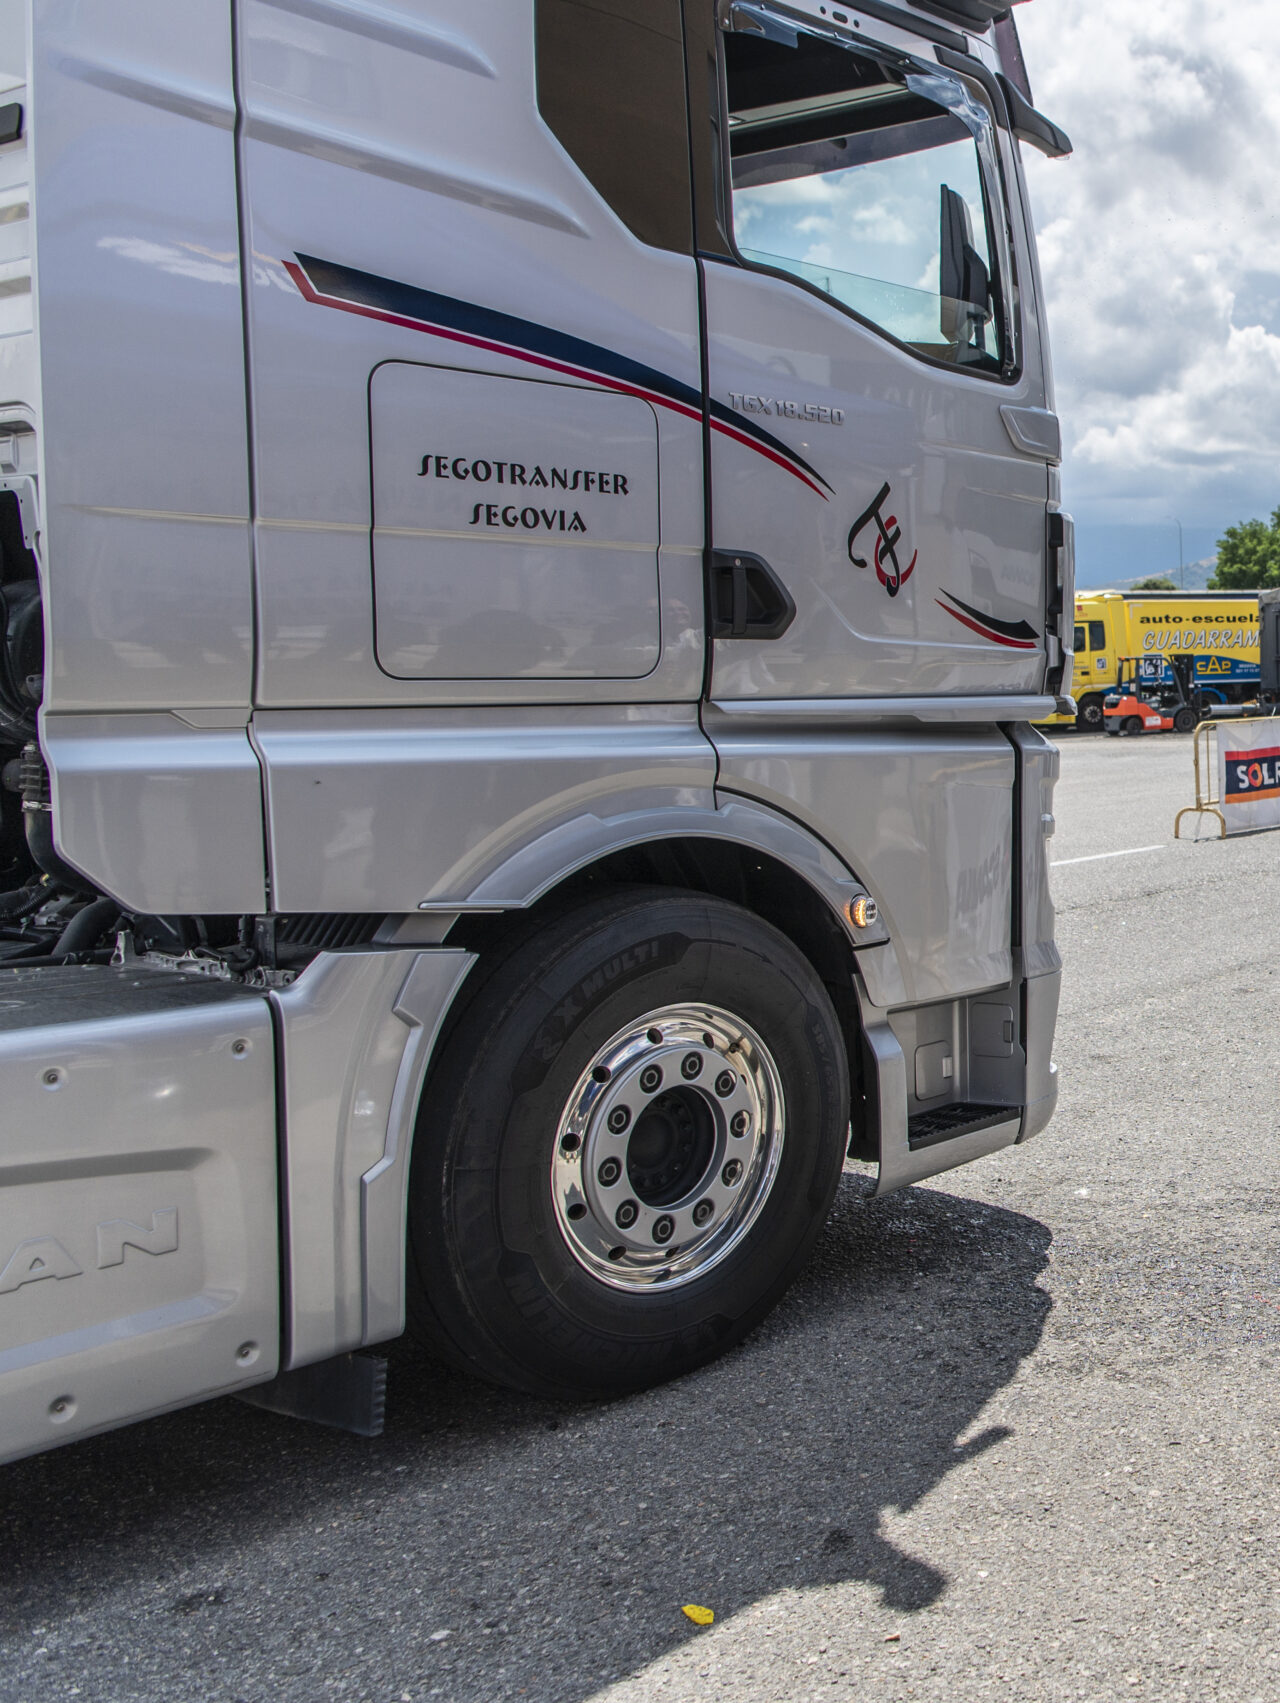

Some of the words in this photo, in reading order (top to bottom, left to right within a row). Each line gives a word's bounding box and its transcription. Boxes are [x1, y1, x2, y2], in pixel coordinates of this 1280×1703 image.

[728, 391, 773, 416] TGX
[776, 399, 846, 427] 18.520
[416, 454, 630, 497] SEGOTRANSFER
[468, 502, 588, 534] SEGOVIA
